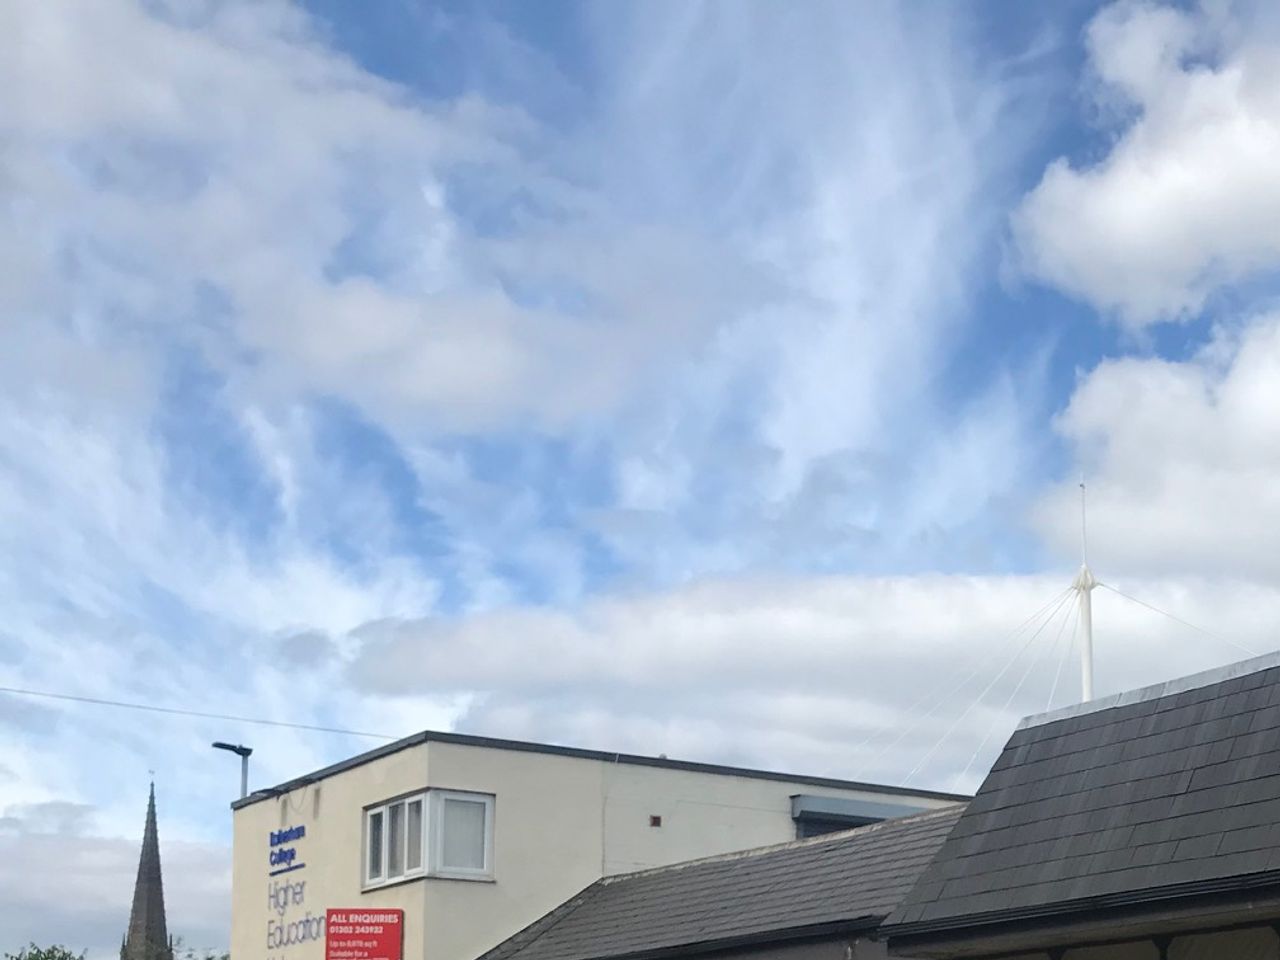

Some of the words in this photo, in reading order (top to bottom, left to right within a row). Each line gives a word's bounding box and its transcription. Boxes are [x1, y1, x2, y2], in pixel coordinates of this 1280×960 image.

[268, 878, 306, 916] Higher
[267, 911, 327, 949] Education
[330, 914, 347, 923] ALL
[349, 914, 398, 923] ENQUIRIES
